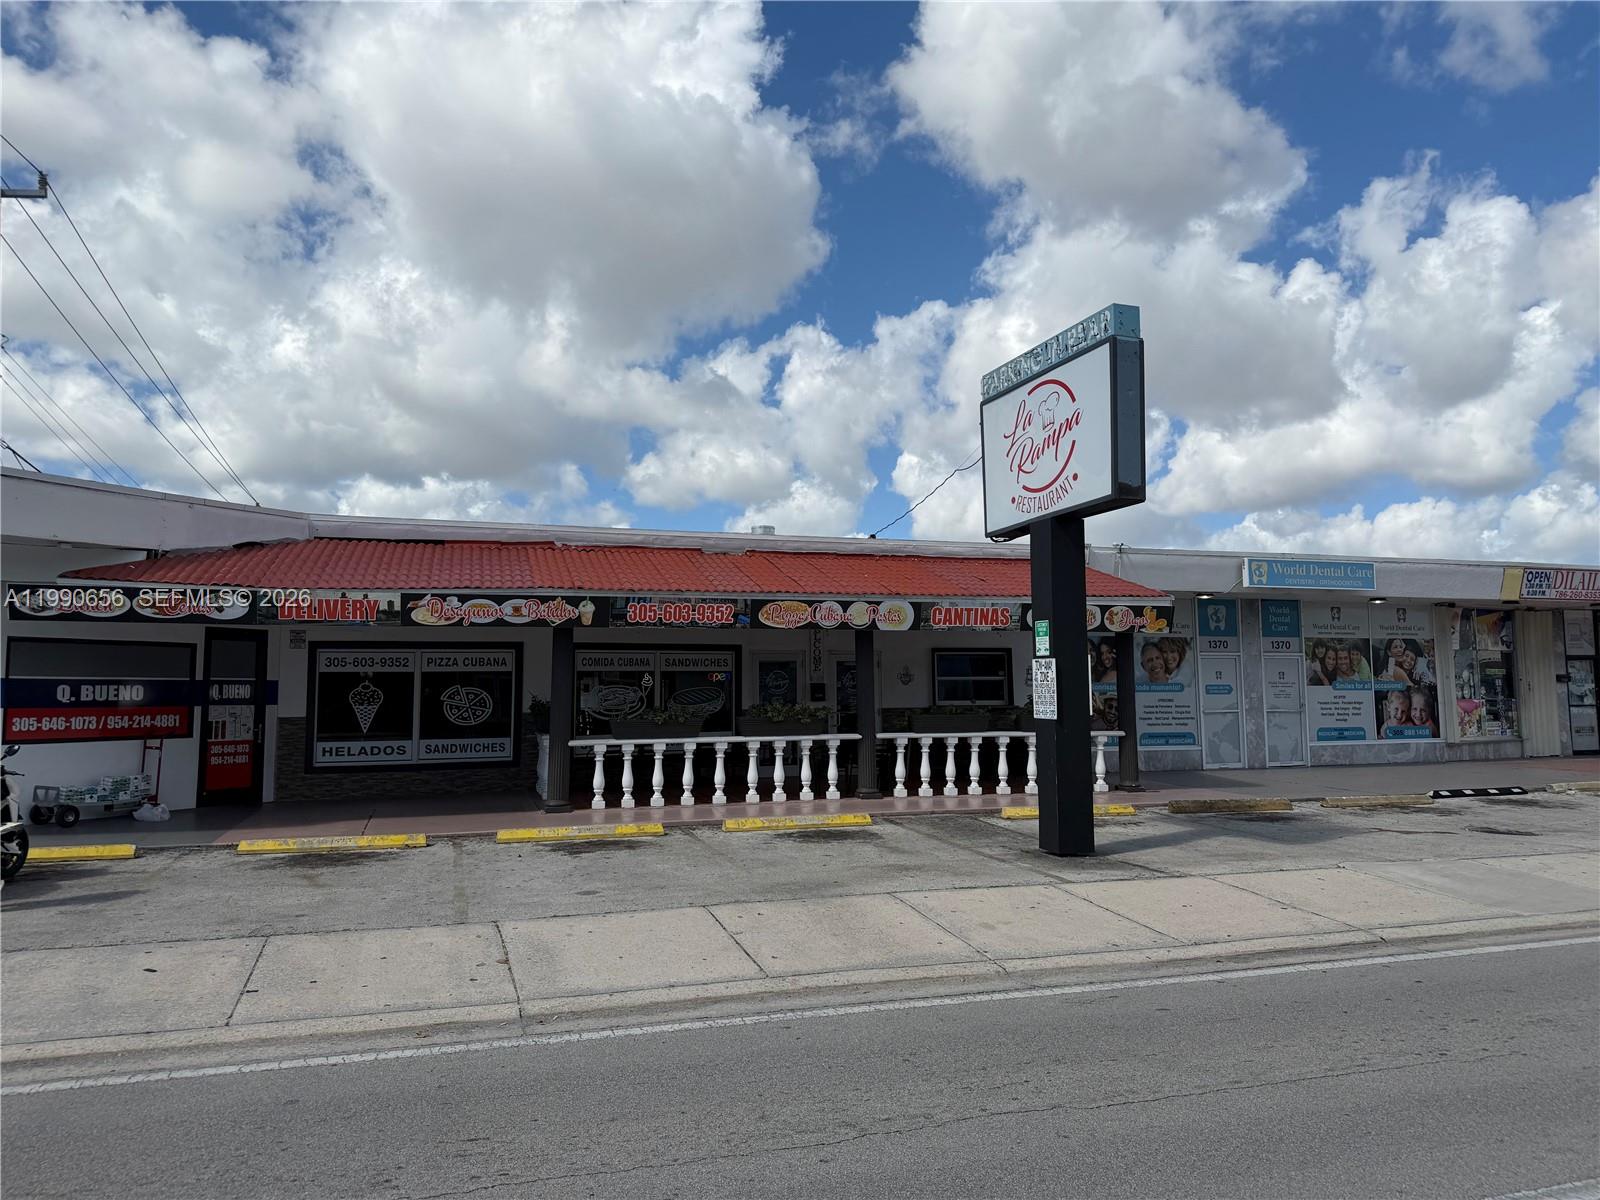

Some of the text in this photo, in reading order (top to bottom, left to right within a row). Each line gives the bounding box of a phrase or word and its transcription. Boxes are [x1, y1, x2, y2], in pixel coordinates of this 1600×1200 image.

[1003, 399, 1034, 458] La
[1009, 407, 1084, 485] Rampa
[1015, 477, 1073, 514] RESTAURANT
[1272, 562, 1373, 578] World Dental Care
[1526, 571, 1552, 583] OPEN
[278, 598, 380, 621] DELIVERY
[426, 596, 578, 626] Desayunos Batidos
[627, 603, 734, 624] 305-603-9352
[768, 603, 806, 629] Pizza
[809, 603, 853, 624] Cubana
[931, 606, 1011, 627] CANTINAS
[1268, 605, 1290, 614] World
[1118, 609, 1151, 632] Jugos
[1269, 615, 1291, 623] Dental
[1272, 623, 1289, 632] Care
[1208, 640, 1229, 649] 1370
[1271, 640, 1291, 650] 1370
[324, 656, 410, 668] 305-603-9352
[426, 657, 507, 667] PIZZA CUBANA
[581, 657, 651, 667] COMIDA CUBANA
[664, 657, 729, 668] SANDWICHES
[56, 685, 145, 703] Q. BUENO
[222, 683, 251, 700] BUENO
[12, 716, 97, 732] 305-646-1073
[107, 714, 180, 729] 954-214-4881
[321, 745, 407, 757] HELADOS
[424, 742, 506, 755] SANDWICHES
